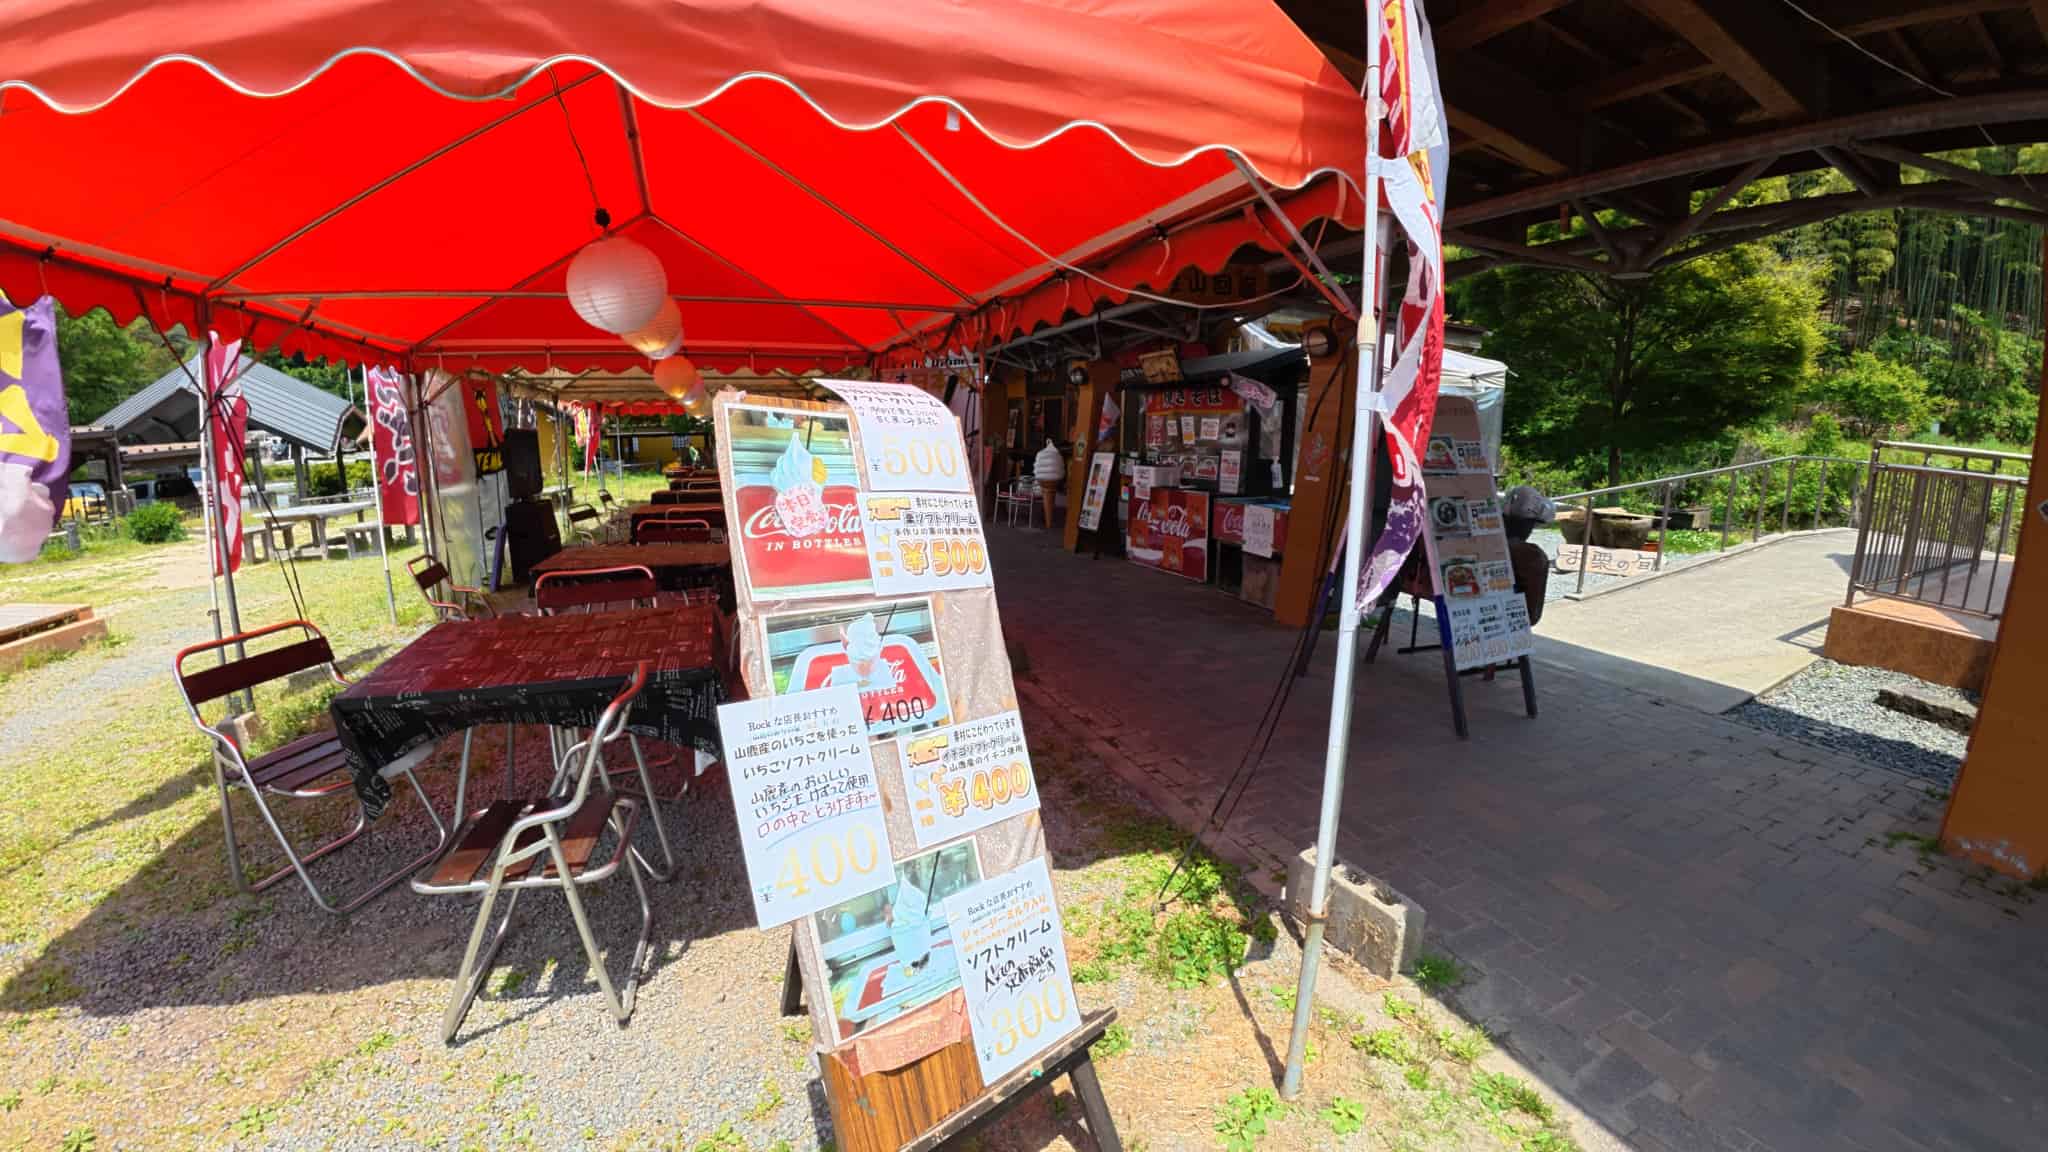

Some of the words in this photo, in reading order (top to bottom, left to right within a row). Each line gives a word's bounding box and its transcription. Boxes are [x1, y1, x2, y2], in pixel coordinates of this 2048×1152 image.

[883, 435, 958, 477] 500
[897, 538, 986, 577] ¥500
[743, 743, 861, 779] いちごソフトクリーム
[937, 761, 1032, 818] ¥400
[775, 824, 879, 898] 400
[967, 919, 1052, 970] ソフトクリーム
[991, 977, 1067, 1056] 300
